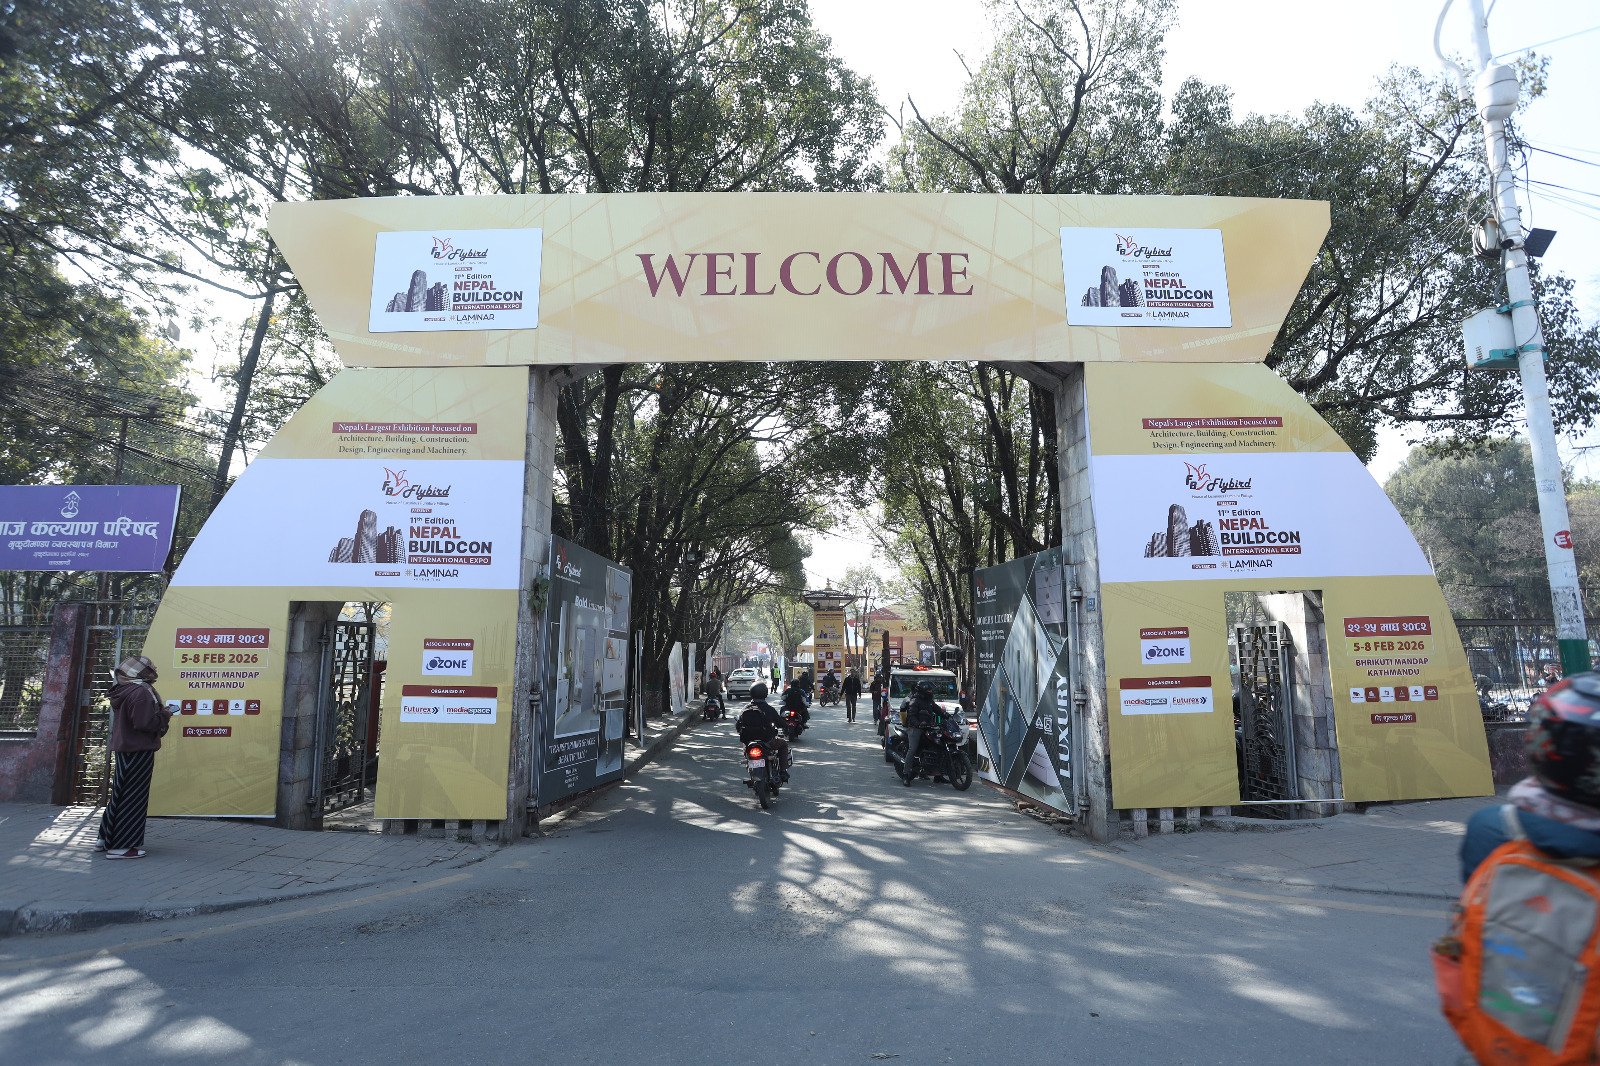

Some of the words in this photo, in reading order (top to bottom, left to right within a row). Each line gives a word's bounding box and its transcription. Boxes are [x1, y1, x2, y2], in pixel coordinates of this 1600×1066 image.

[448, 248, 488, 262] Flybird
[1134, 247, 1172, 258] Flybird
[466, 272, 492, 280] Edition
[635, 252, 974, 297] WELCOME
[453, 280, 496, 290] NEPAL
[1144, 278, 1186, 288] NEPAL
[452, 291, 523, 302] BUILDCON
[1145, 289, 1214, 300] BUILDCON
[365, 424, 391, 433] Largest
[392, 424, 430, 432] Exhibition
[432, 424, 460, 432] Focused
[1175, 420, 1200, 428] Largest
[1239, 418, 1267, 426] Focused
[1180, 441, 1223, 449] Engineering
[367, 446, 411, 456] Engineering
[411, 446, 425, 454] and
[1207, 478, 1252, 493] Flybird
[402, 485, 451, 500] Flybird
[30, 522, 99, 536] कल्याण
[1219, 518, 1269, 530] NEPAL
[410, 526, 461, 539] NEPAL
[1221, 531, 1300, 544] BUILDCON
[409, 541, 492, 554] BUILDCON
[1380, 623, 1400, 631] माघ
[1402, 623, 1427, 631] २०८२
[213, 634, 235, 644] माघ
[238, 634, 265, 644] २०८२
[1354, 642, 1371, 651] 5-8
[1374, 641, 1394, 651] FEB
[1397, 641, 1424, 650] 2026
[181, 654, 200, 663] 5-8
[203, 654, 225, 663] FEB
[228, 654, 258, 663] 2026
[1056, 672, 1070, 778] LUXURY
